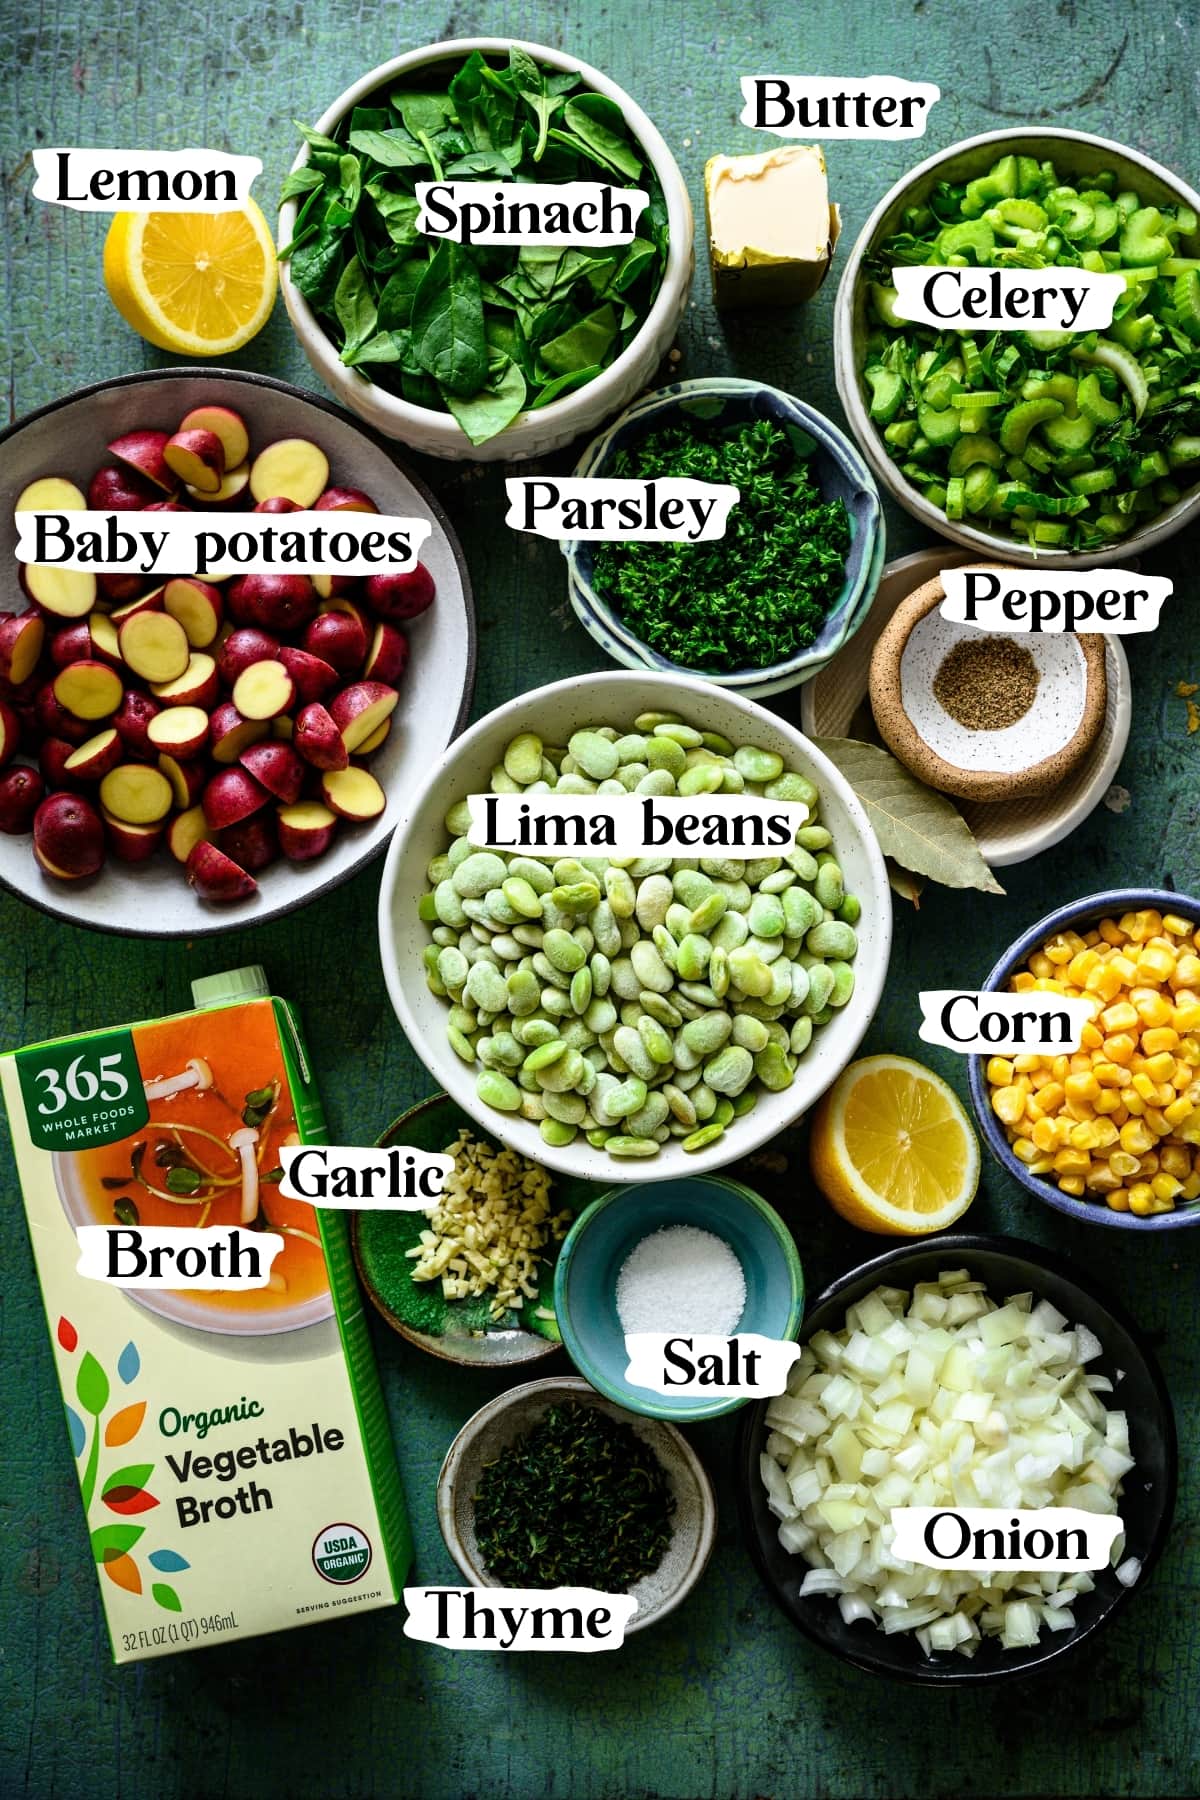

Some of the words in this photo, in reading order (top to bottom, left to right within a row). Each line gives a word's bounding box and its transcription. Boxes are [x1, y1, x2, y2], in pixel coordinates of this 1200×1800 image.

[34, 1053, 128, 1114] 365
[42, 1115, 88, 1133] WHOLE
[92, 1106, 135, 1122] FOODS
[65, 1121, 117, 1141] MARKET
[158, 1397, 264, 1439] Organic
[165, 1423, 344, 1483] Vegetable
[176, 1481, 273, 1529] Broth
[323, 1535, 357, 1554] USDA
[323, 1553, 365, 1570] ORGANIC
[296, 1602, 330, 1614] SERVING
[331, 1591, 382, 1607] SUGGESTION
[122, 1633, 138, 1652] 32
[138, 1630, 152, 1649] FL
[152, 1626, 168, 1645] OZ
[168, 1623, 180, 1645] (1
[180, 1618, 199, 1642] QT)
[200, 1611, 239, 1635] 946mL
